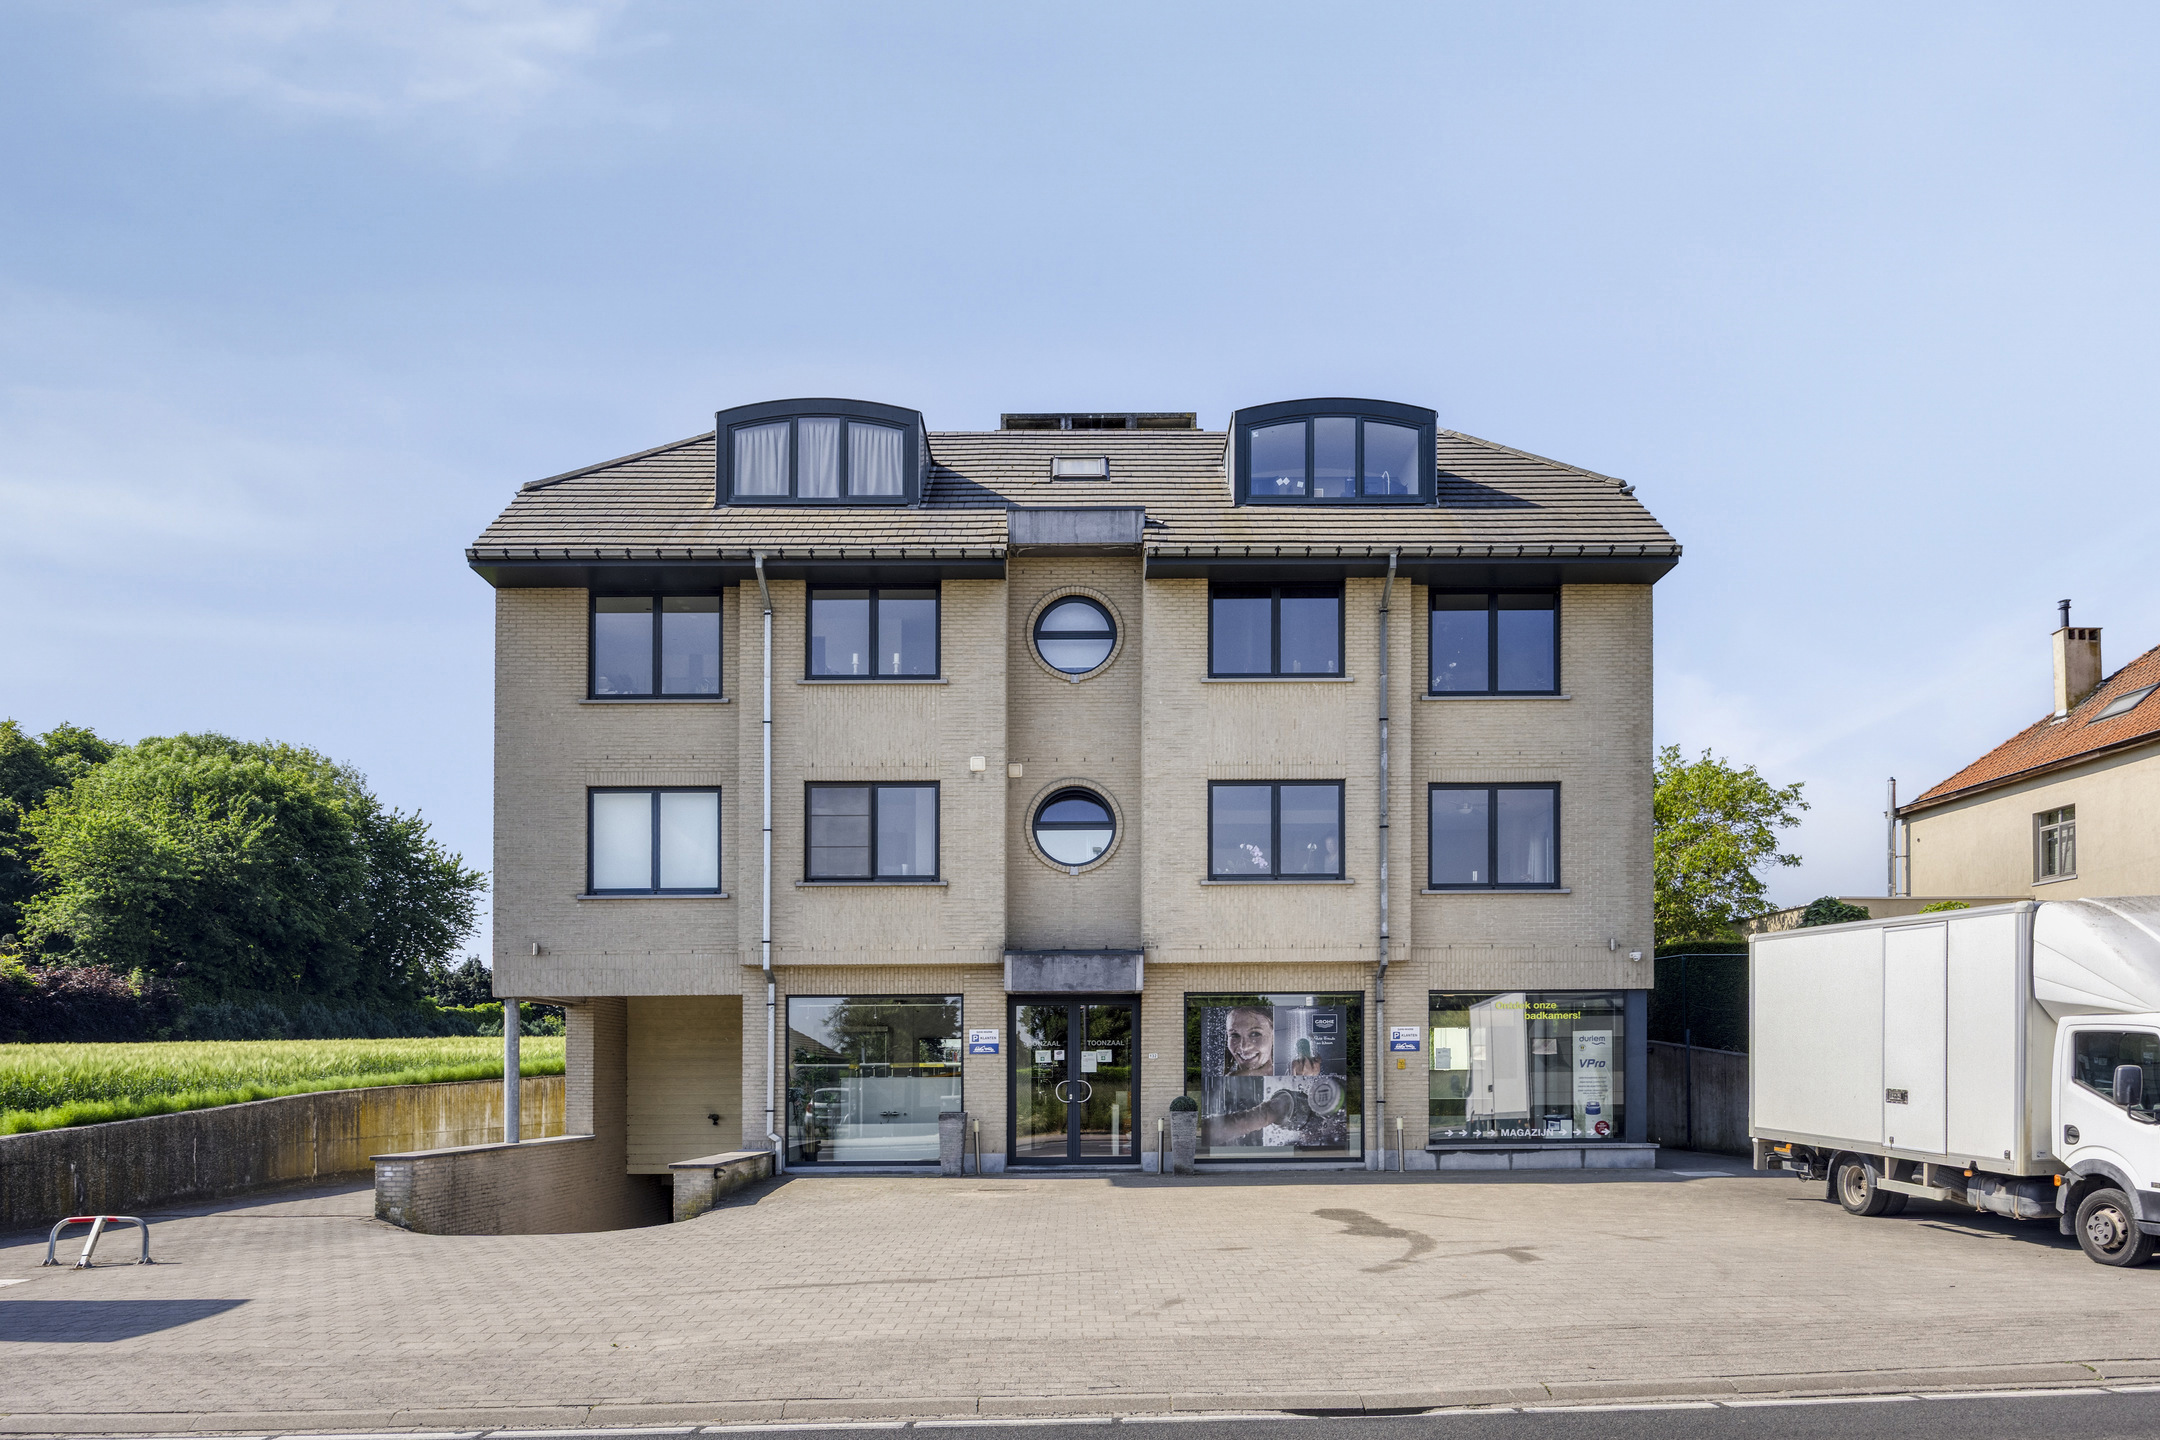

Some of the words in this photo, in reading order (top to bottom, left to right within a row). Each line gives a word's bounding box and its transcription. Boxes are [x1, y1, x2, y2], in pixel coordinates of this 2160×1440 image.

[1496, 1001, 1531, 1010] Ontdek
[1533, 1002, 1557, 1010] onze
[1524, 1011, 1581, 1020] badkamers!
[1579, 1059, 1606, 1068] VPro
[1500, 1128, 1554, 1137] MAGAZIJN
